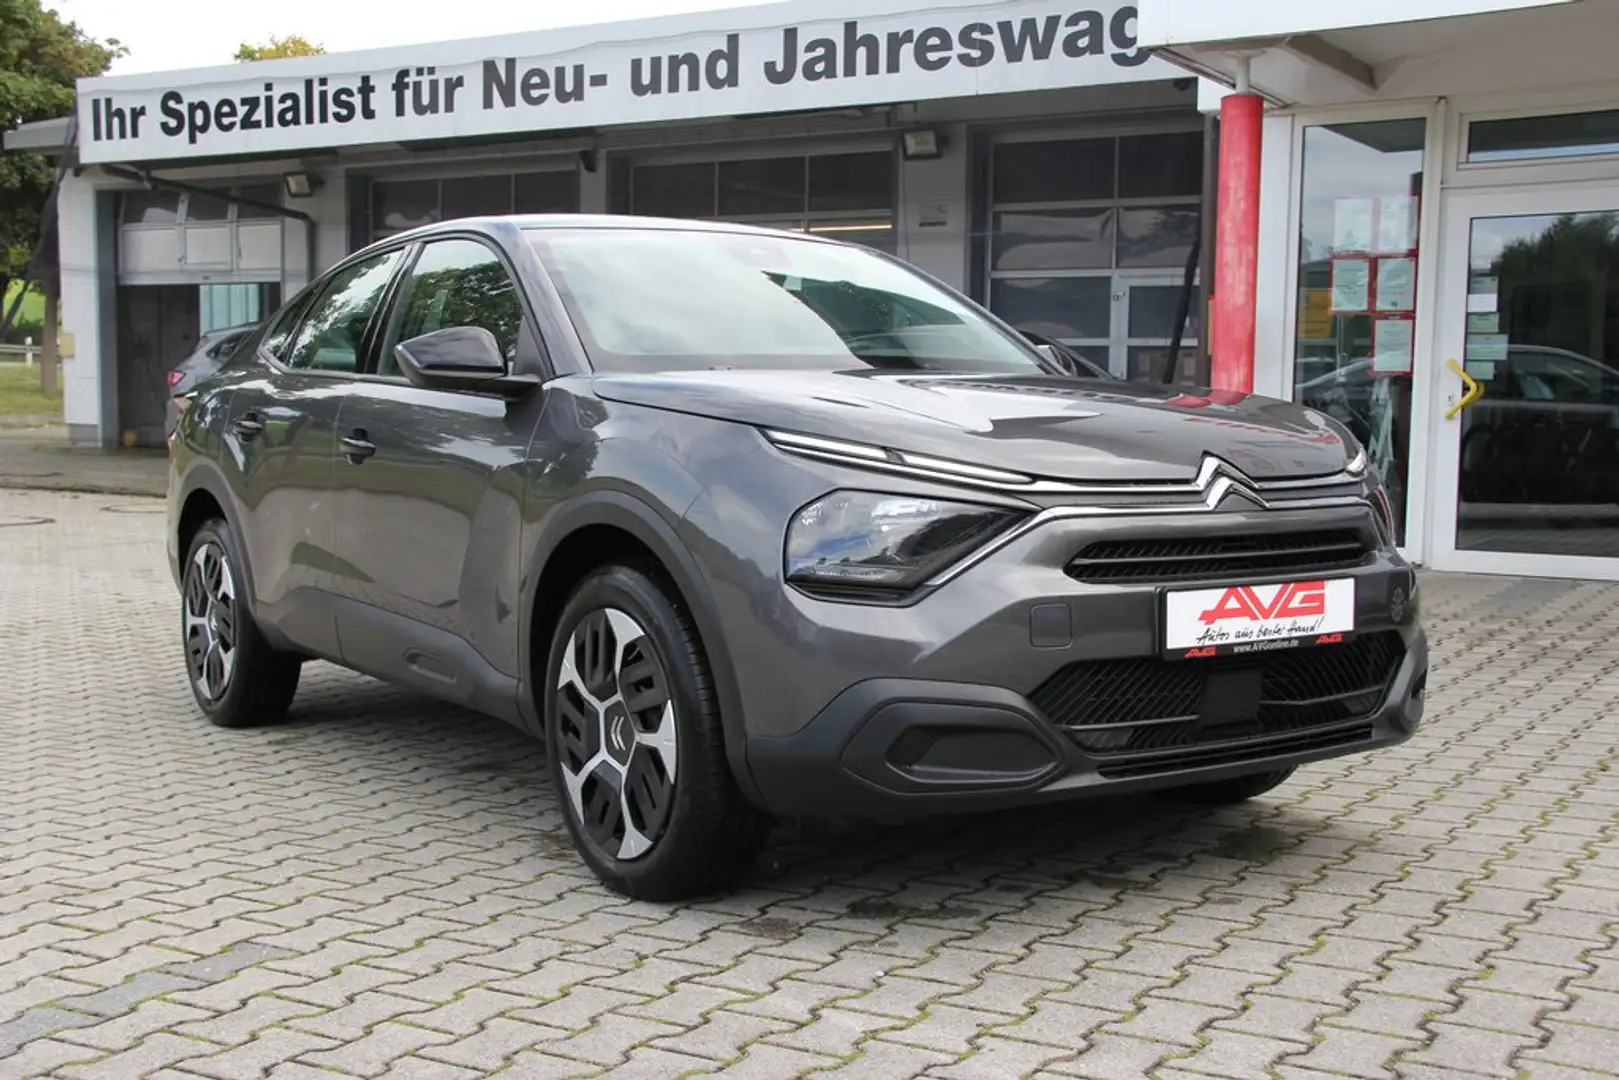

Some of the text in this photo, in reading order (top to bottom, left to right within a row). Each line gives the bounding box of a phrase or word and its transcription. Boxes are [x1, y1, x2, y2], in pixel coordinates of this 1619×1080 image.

[91, 98, 147, 142] Ihr
[160, 75, 376, 145] Spezialist
[392, 65, 464, 117] für
[483, 58, 607, 110] Neu-
[631, 33, 740, 97] und
[1198, 580, 1325, 625] AVG
